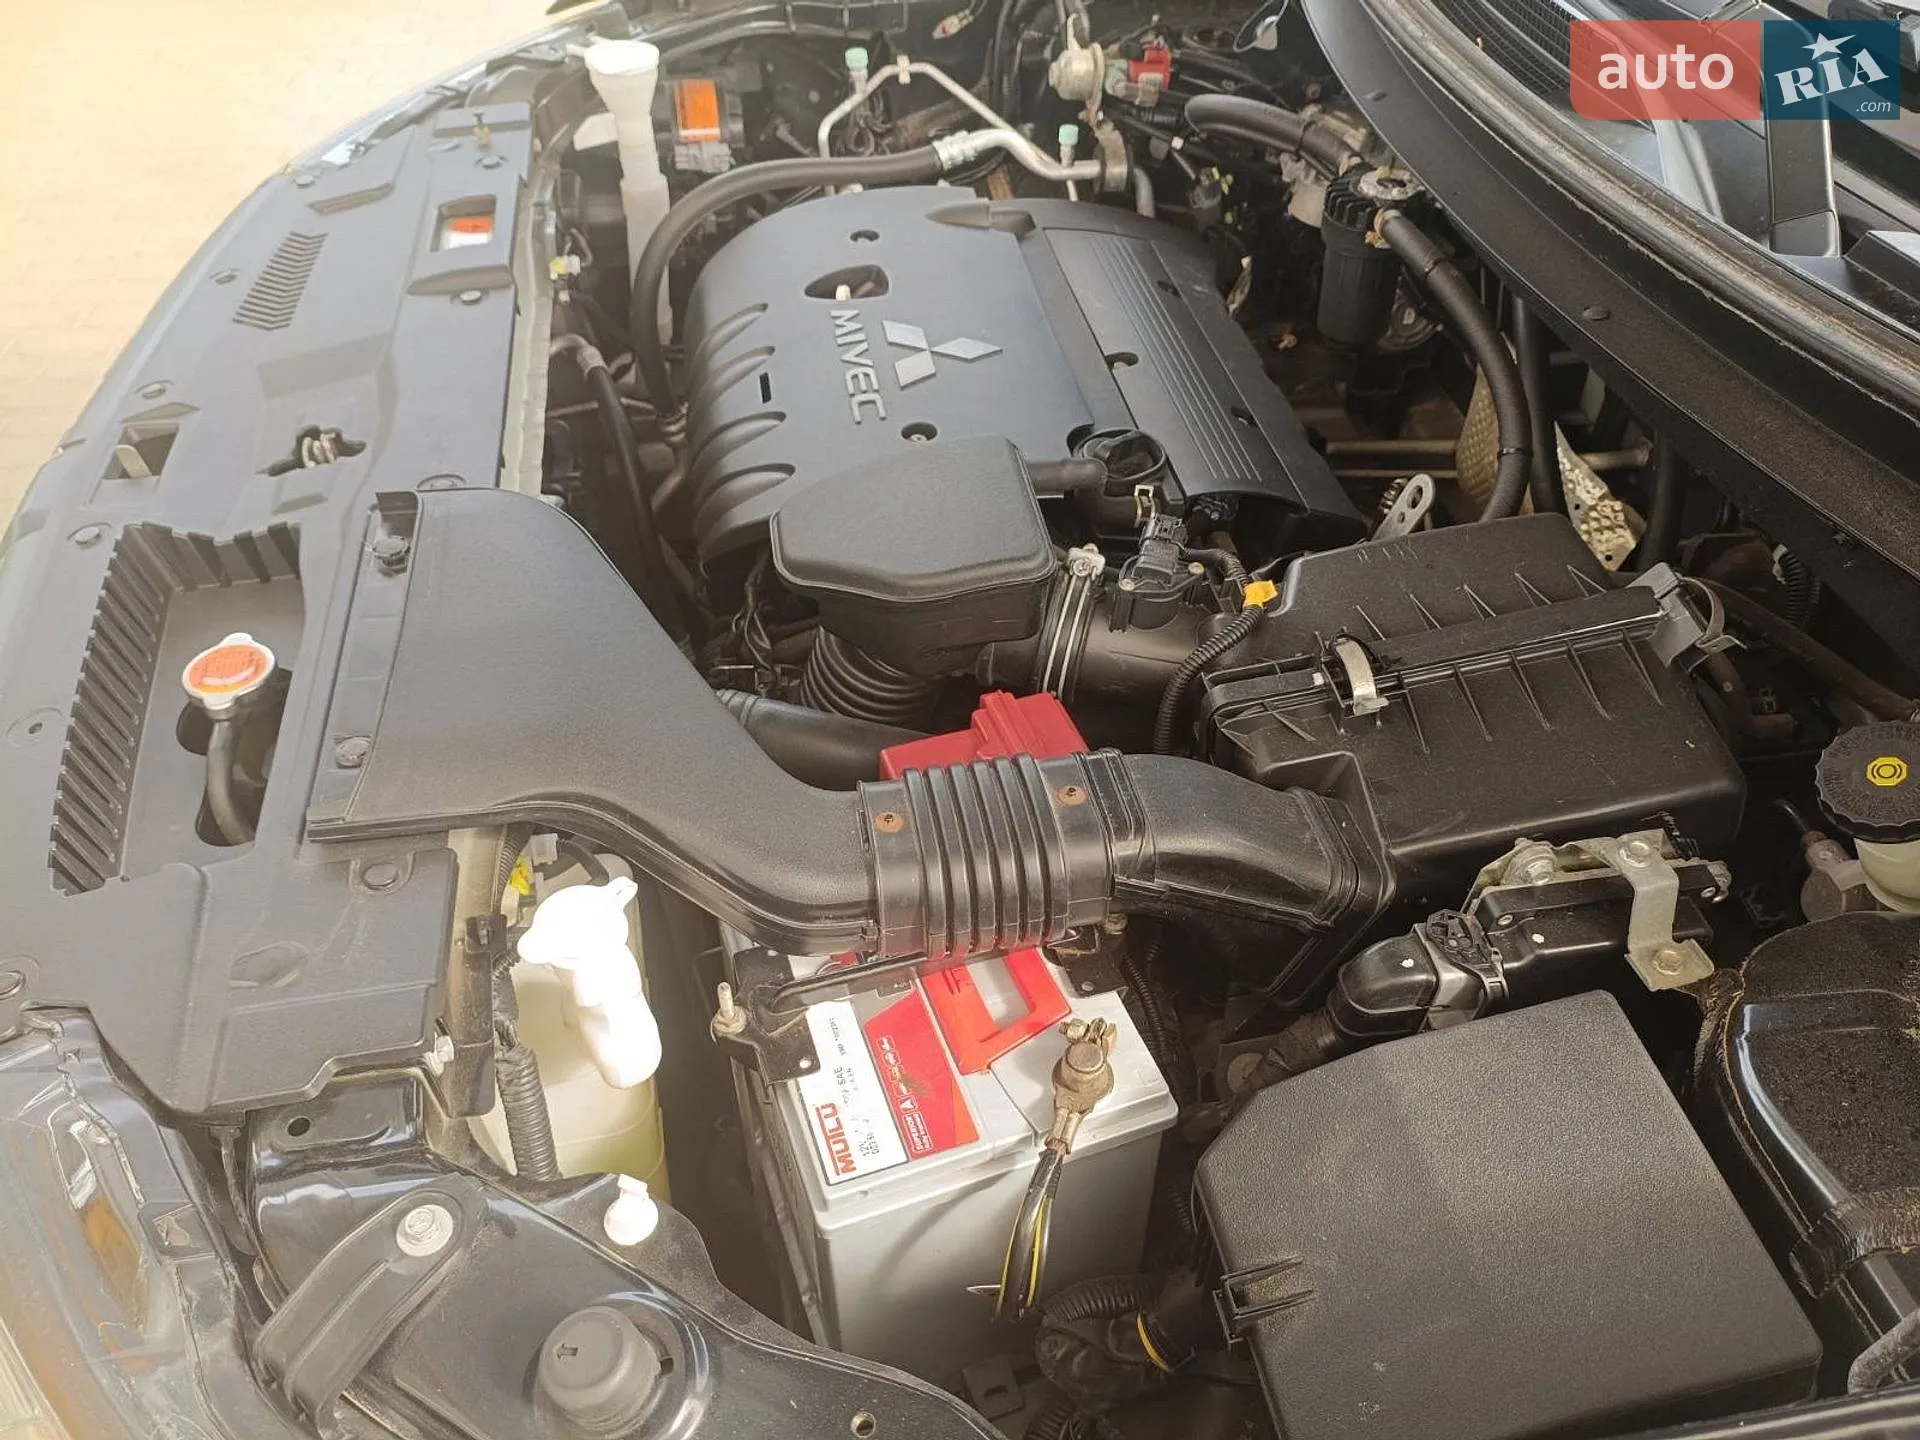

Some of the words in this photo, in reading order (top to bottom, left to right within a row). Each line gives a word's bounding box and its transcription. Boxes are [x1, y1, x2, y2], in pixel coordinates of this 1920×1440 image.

[830, 309, 887, 425] MIVEC
[833, 1066, 847, 1086] SAE
[815, 1102, 857, 1176] MUTLU
